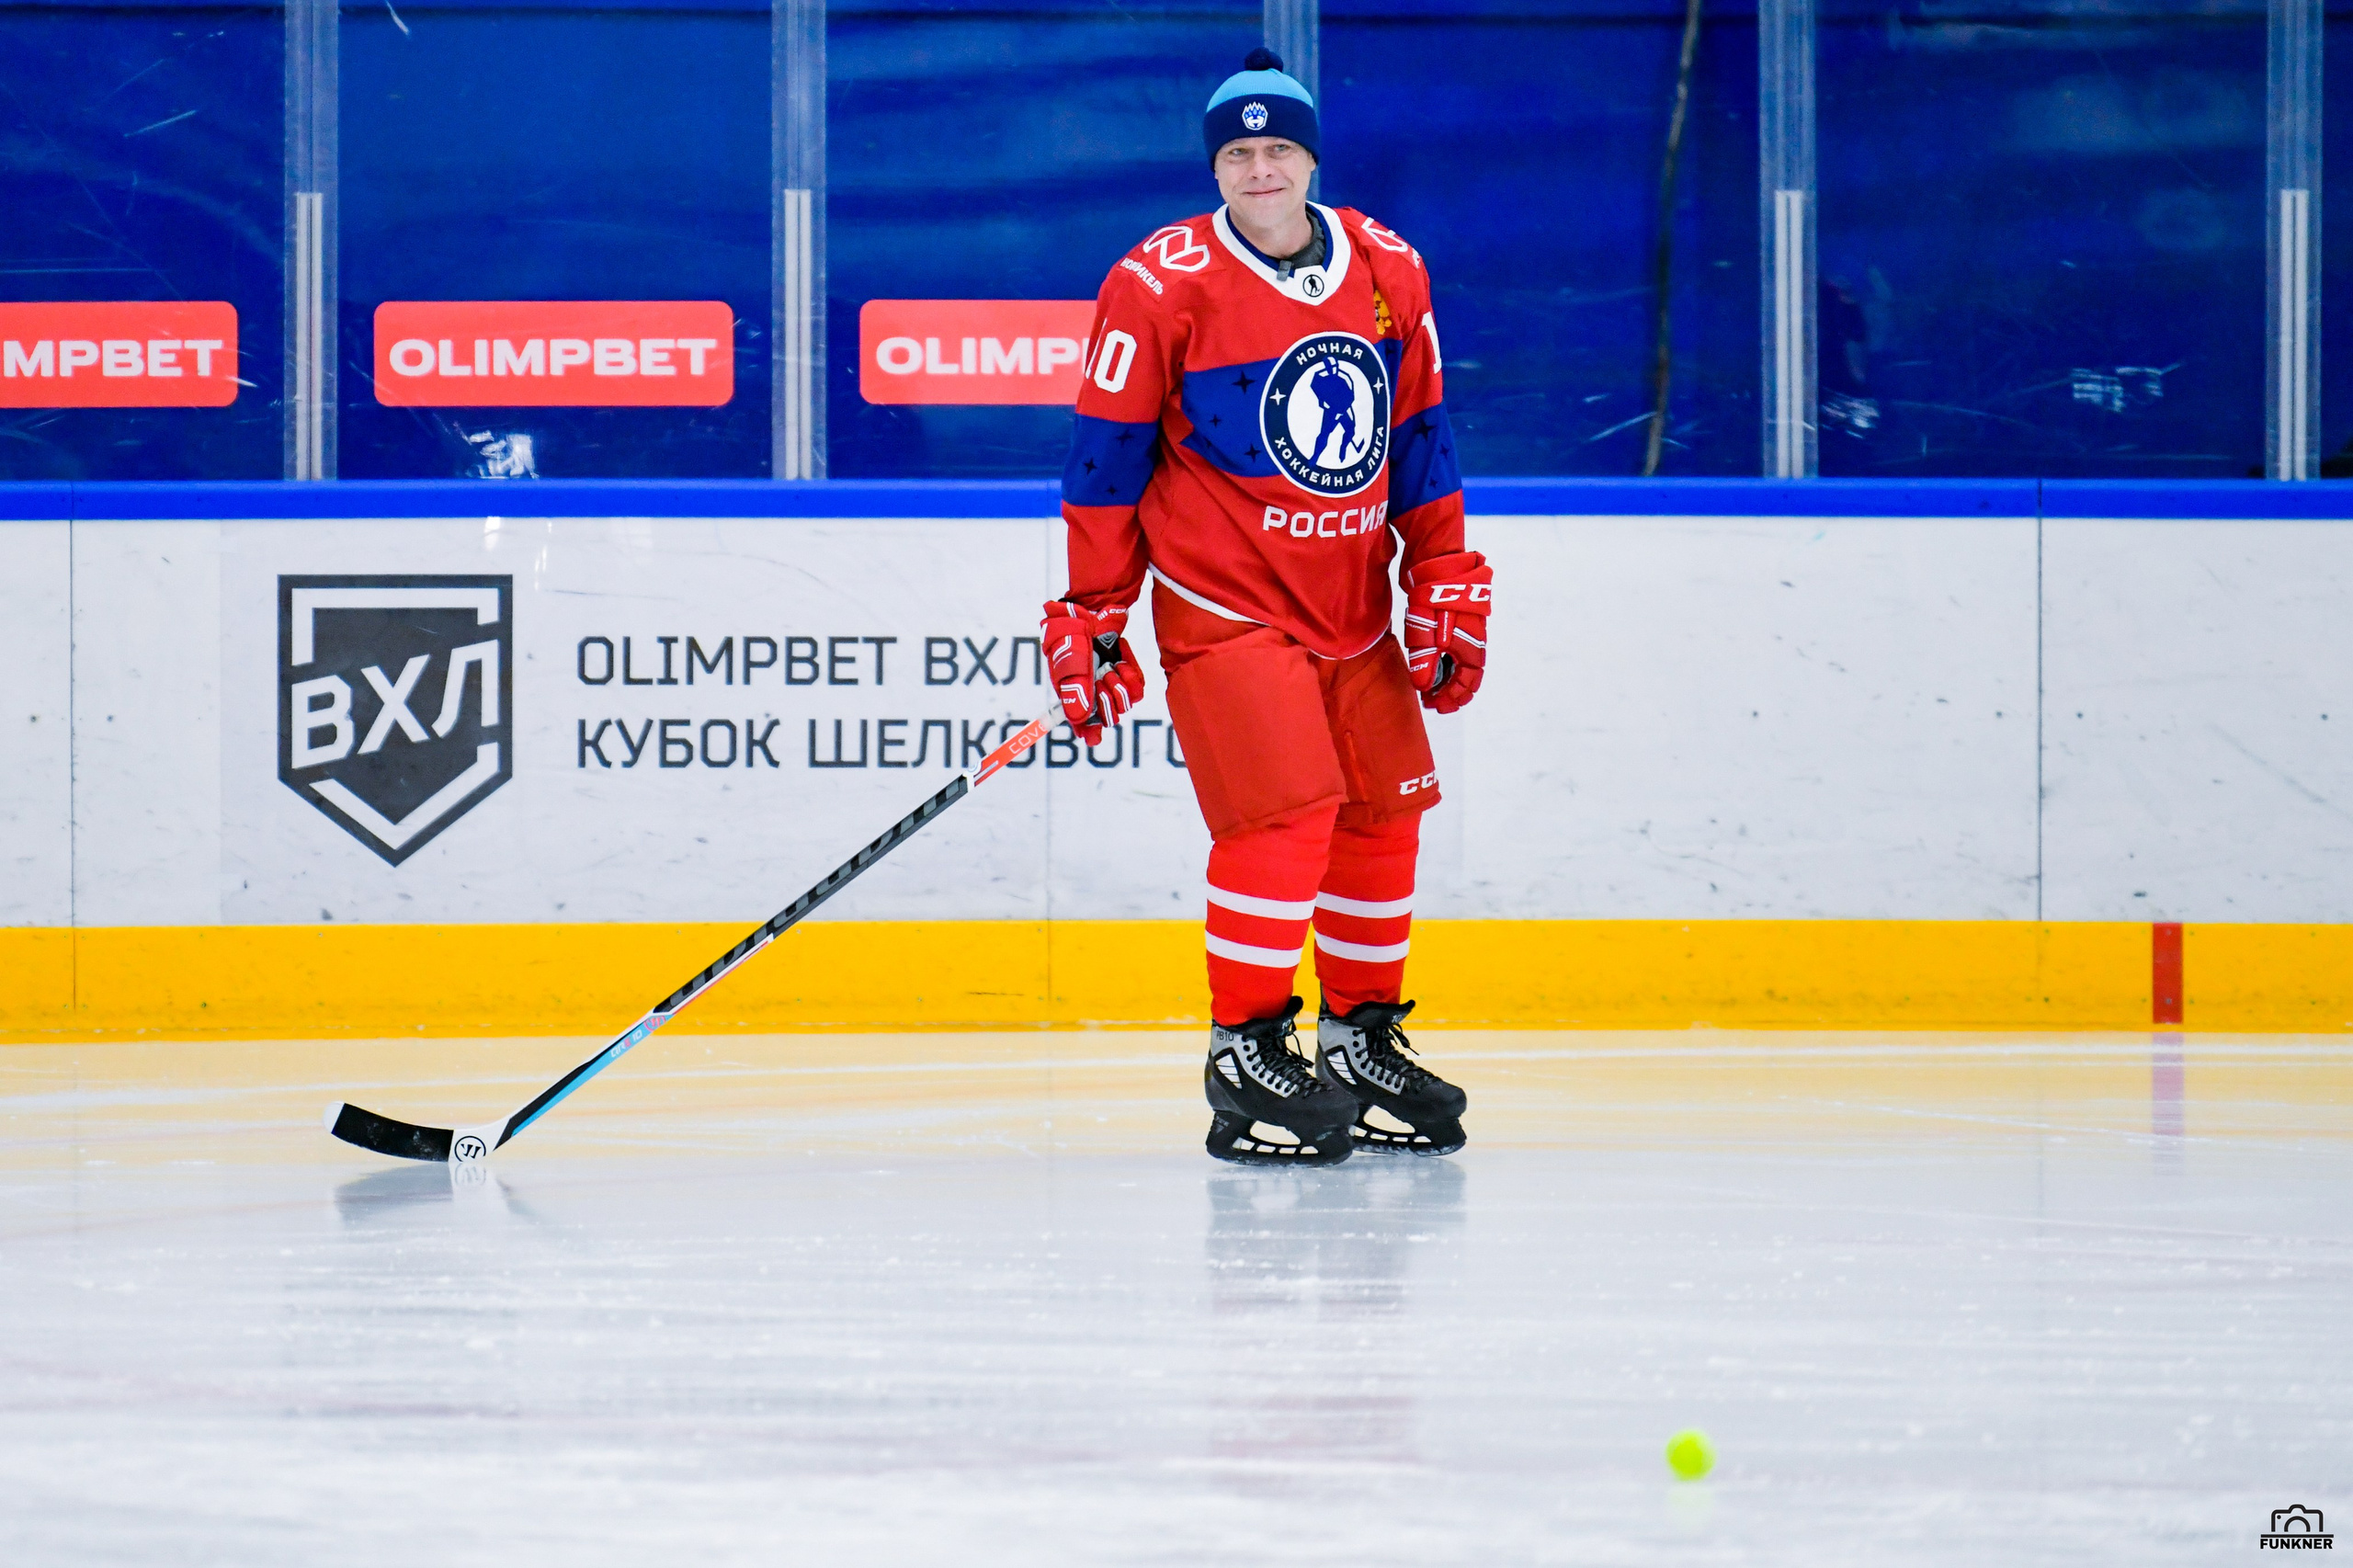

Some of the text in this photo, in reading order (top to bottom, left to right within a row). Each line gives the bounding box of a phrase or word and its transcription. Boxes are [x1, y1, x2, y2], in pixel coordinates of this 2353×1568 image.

[4, 338, 222, 378] MPBET
[389, 338, 718, 378] OLIMPBET
[1296, 342, 1363, 366] НОЧНАЯ
[1275, 426, 1384, 487] ХОККЕЙНАЯ ЛИГА
[1263, 499, 1389, 539] РОССИЯ
[577, 636, 1041, 686] OLIMPBET ВХЛ
[291, 639, 499, 769] ВХЛ
[577, 718, 780, 768] КУБОК
